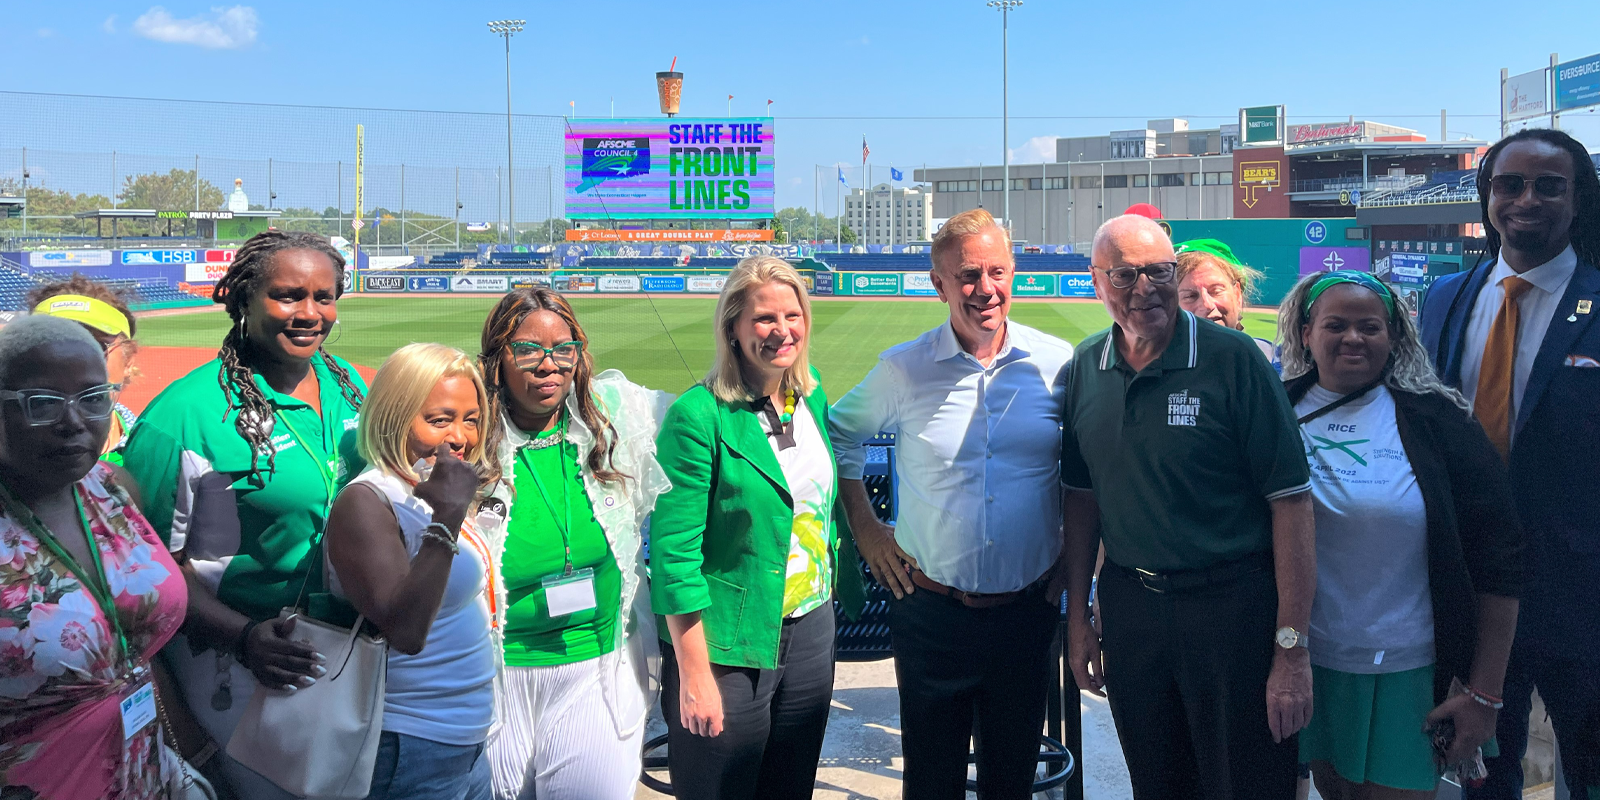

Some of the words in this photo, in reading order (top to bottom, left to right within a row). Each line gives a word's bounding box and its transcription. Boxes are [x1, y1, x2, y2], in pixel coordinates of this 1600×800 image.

[1559, 61, 1600, 81] EVERSOURCE
[1518, 94, 1527, 102] THE
[1518, 100, 1543, 112] HARTFORD
[1261, 120, 1274, 128] Bank
[669, 123, 723, 144] STAFF
[729, 123, 763, 144] THE
[1294, 124, 1361, 142] Budweiser
[597, 140, 636, 149] AFSCME
[594, 149, 631, 157] COUNCIL
[632, 149, 638, 157] 4
[669, 146, 761, 177] FRONT
[1243, 168, 1276, 177] BEAR'S
[669, 179, 750, 210] LINES
[158, 210, 187, 219] PATRÓN
[189, 211, 211, 219] PARTY
[211, 211, 233, 219] PLAZA
[1308, 226, 1323, 237] 42
[162, 251, 192, 263] HSB
[1067, 277, 1095, 287] choic
[1168, 396, 1187, 404] STAFF
[1168, 404, 1201, 416] FRONT
[1167, 415, 1197, 426] LINES
[1327, 423, 1357, 433] RICE
[1334, 467, 1357, 476] 2022
